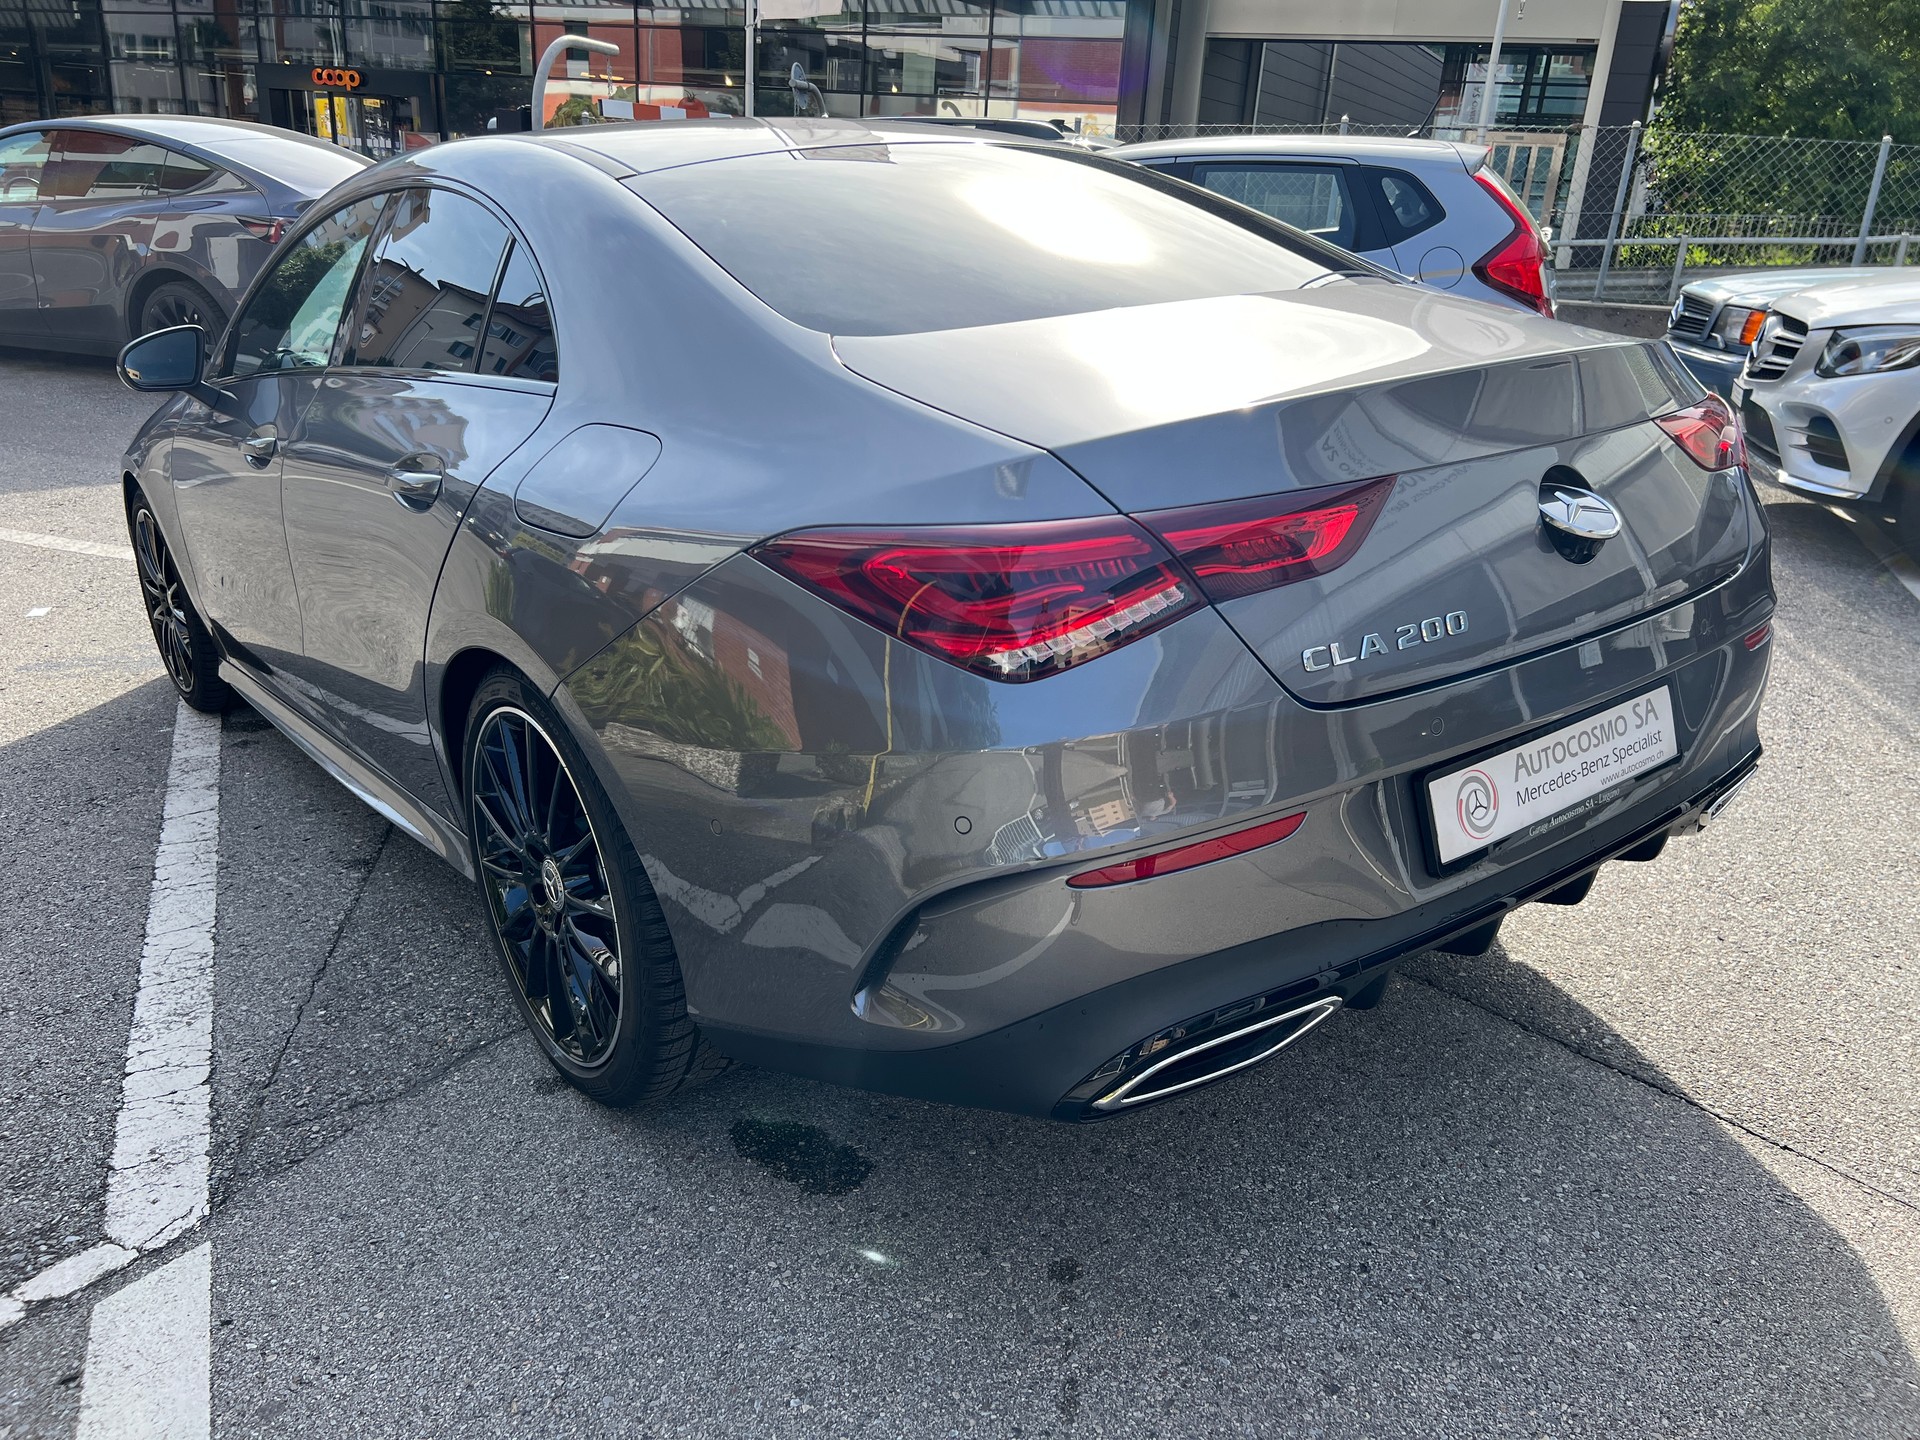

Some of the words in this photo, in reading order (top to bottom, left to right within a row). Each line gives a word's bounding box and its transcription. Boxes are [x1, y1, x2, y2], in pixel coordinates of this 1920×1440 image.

[311, 67, 361, 91] coop
[1302, 632, 1389, 672] CLA
[1395, 610, 1469, 650] 200
[1514, 714, 1628, 783] AUTOCOSMO
[1632, 697, 1659, 730] SA
[1516, 754, 1610, 807] Mercedes-Benz
[1612, 729, 1663, 765] Specialist
[1600, 750, 1665, 786] www.autocosmo.ch
[1549, 804, 1585, 828] Autocosmo
[1585, 798, 1595, 811] SA
